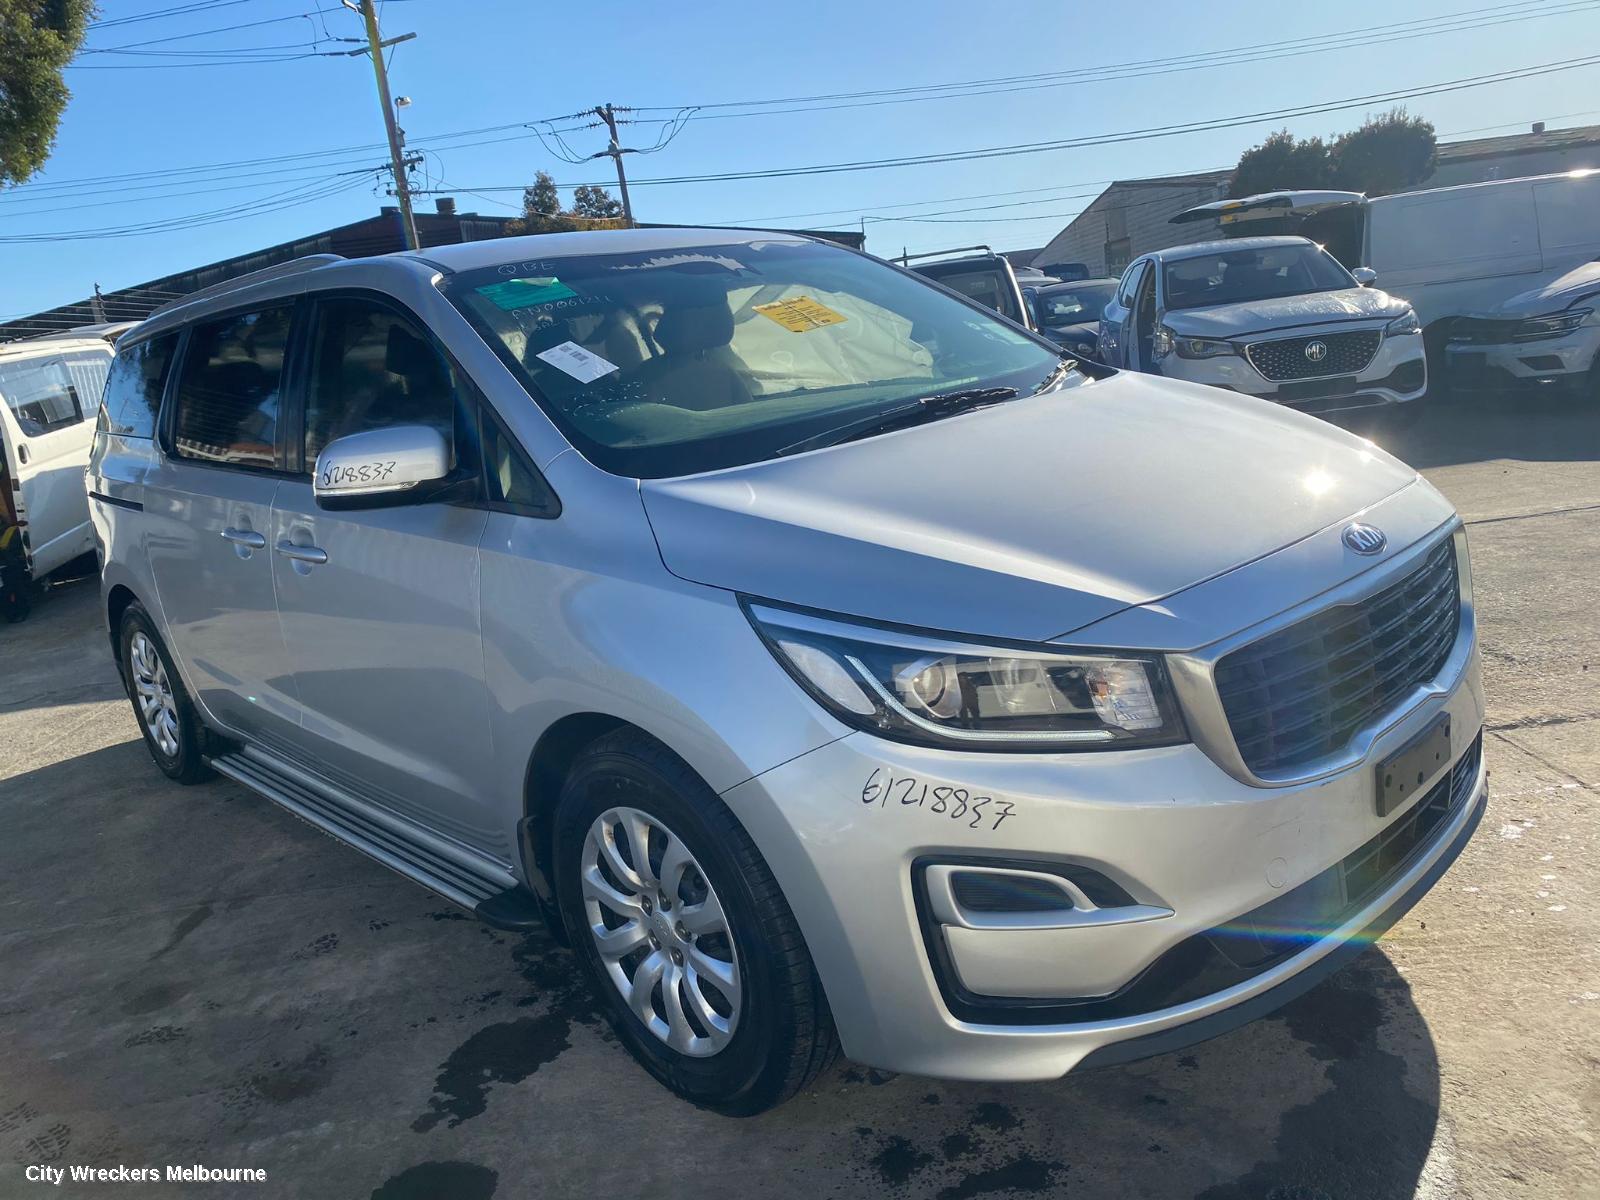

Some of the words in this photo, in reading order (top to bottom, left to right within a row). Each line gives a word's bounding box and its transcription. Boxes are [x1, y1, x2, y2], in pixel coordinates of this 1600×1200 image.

[497, 261, 556, 275] QBE
[1307, 343, 1326, 360] MG
[1346, 525, 1384, 551] KIA
[861, 767, 1016, 830] 61218837
